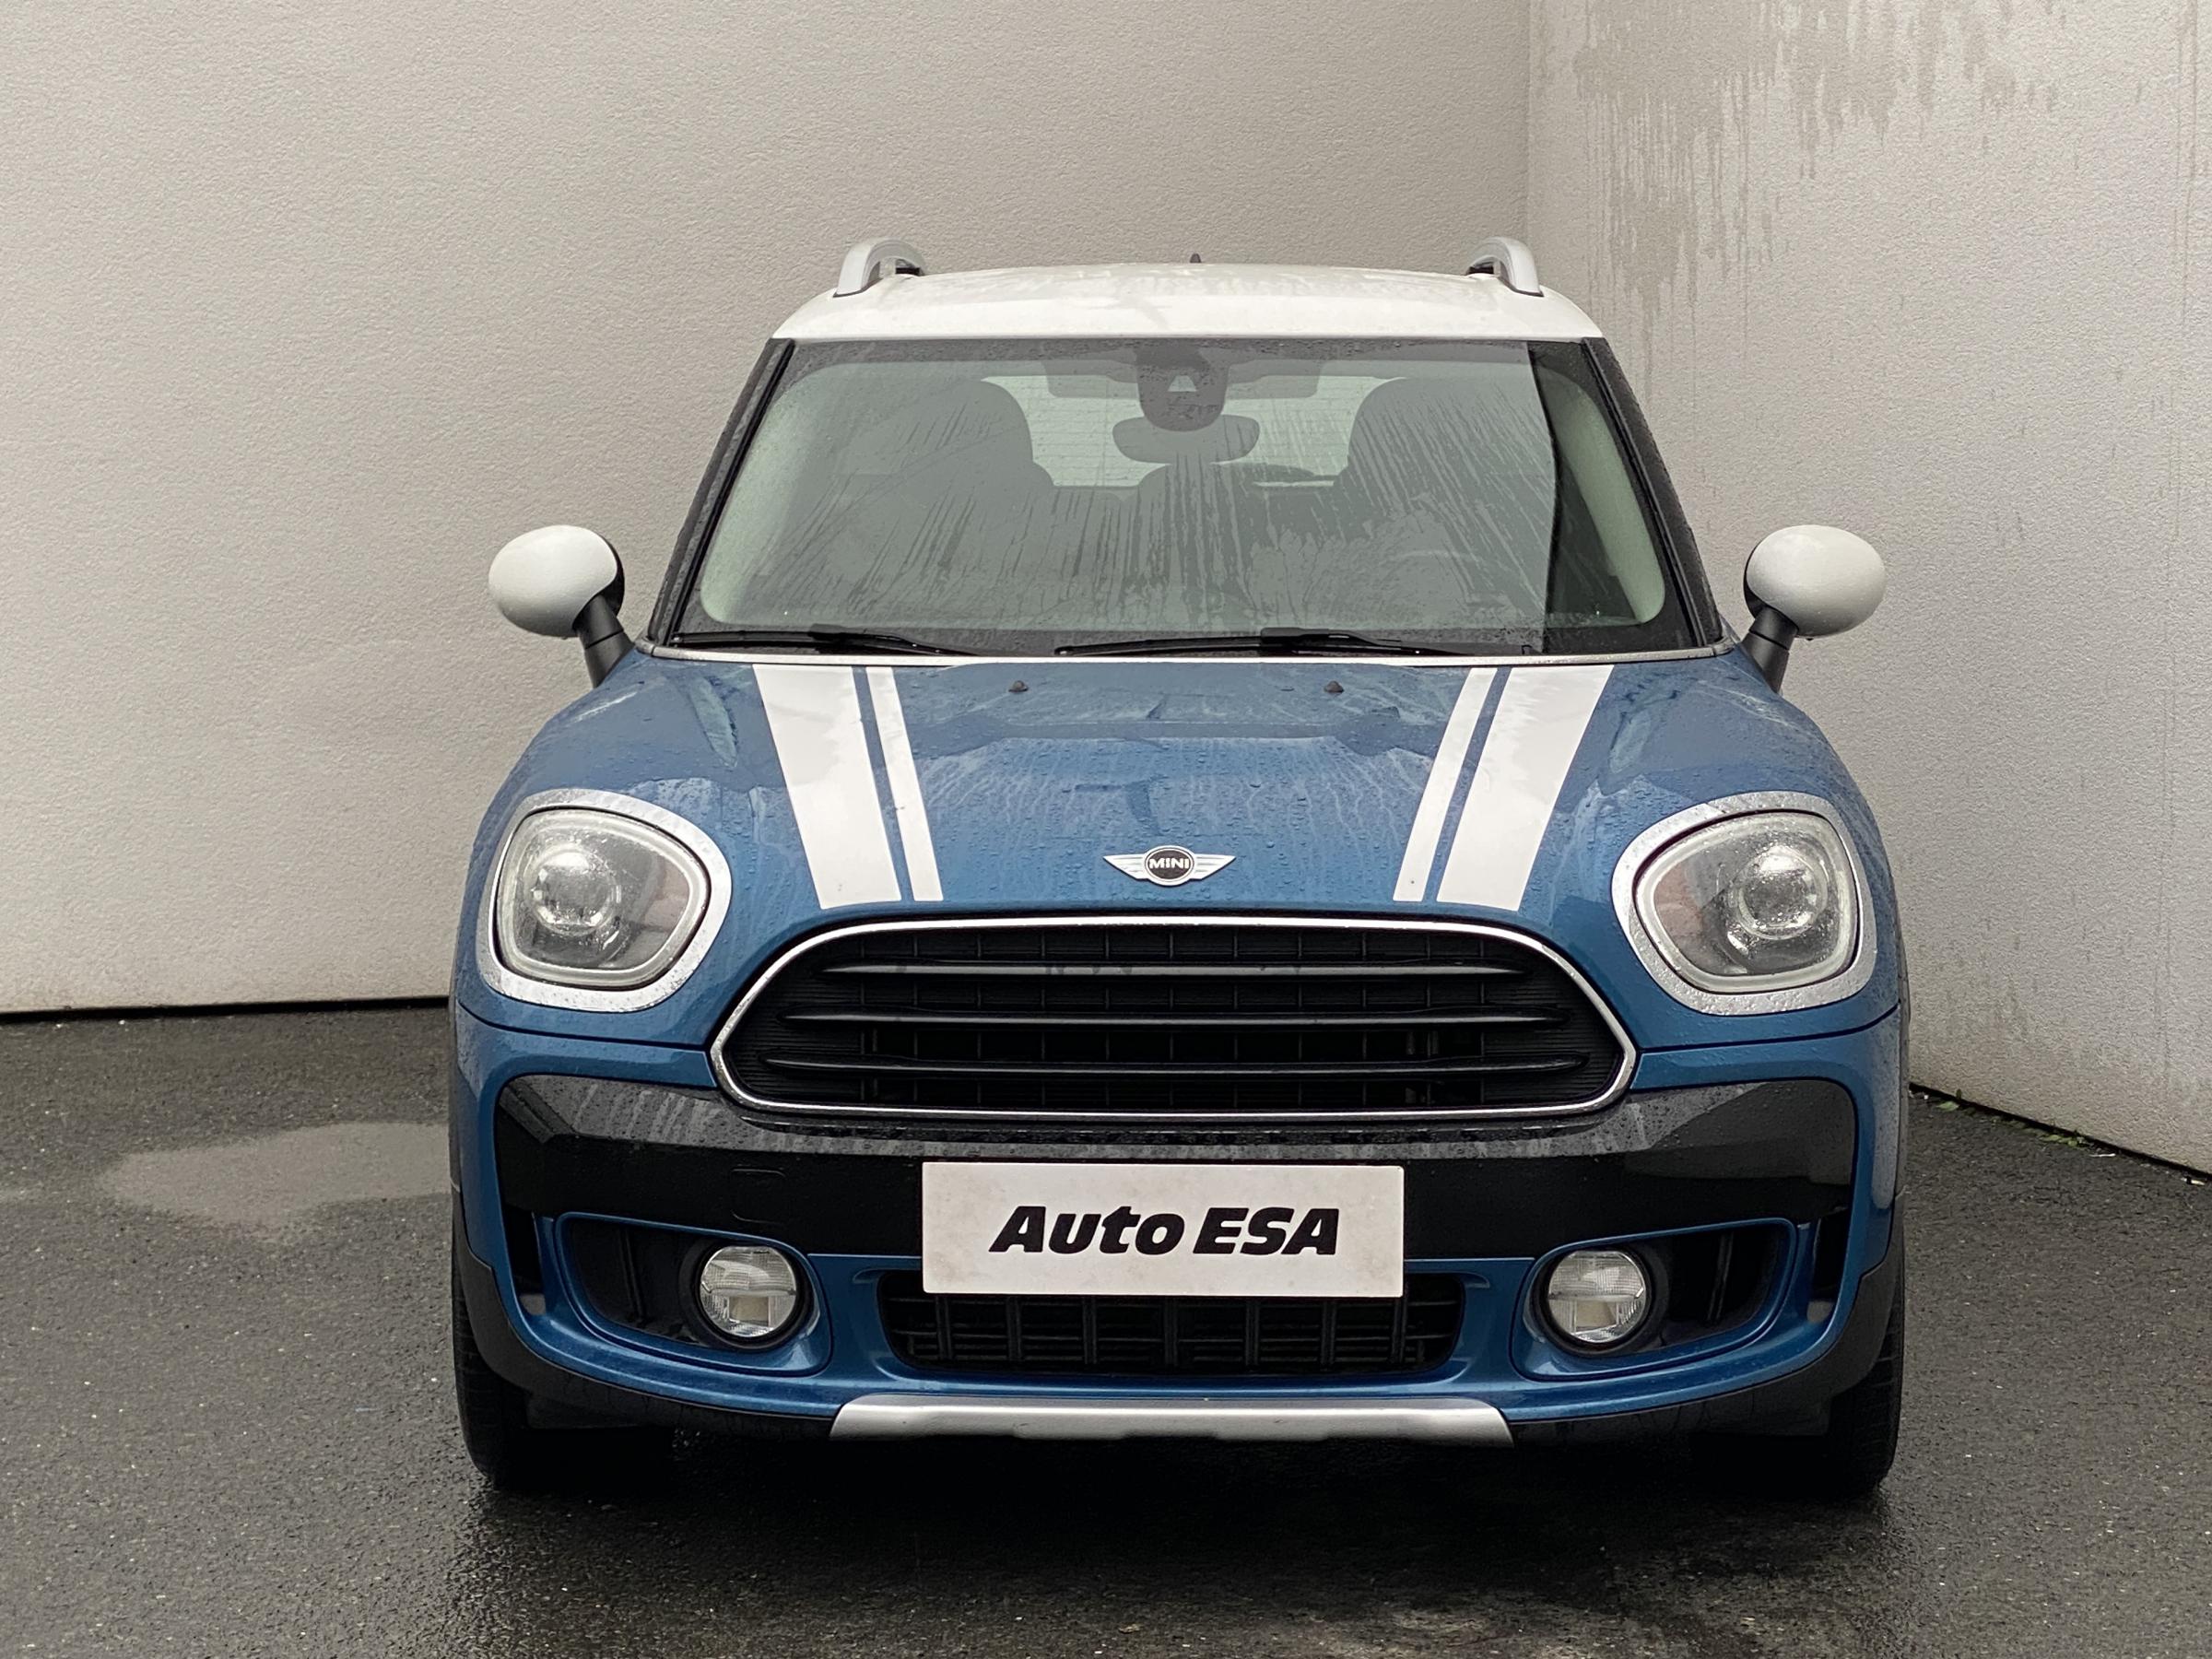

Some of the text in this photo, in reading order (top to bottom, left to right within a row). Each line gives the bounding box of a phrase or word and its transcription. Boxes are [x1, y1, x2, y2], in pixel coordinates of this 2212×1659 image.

[1149, 858, 1190, 869] MINI
[989, 1206, 1339, 1255] Auto ESA
